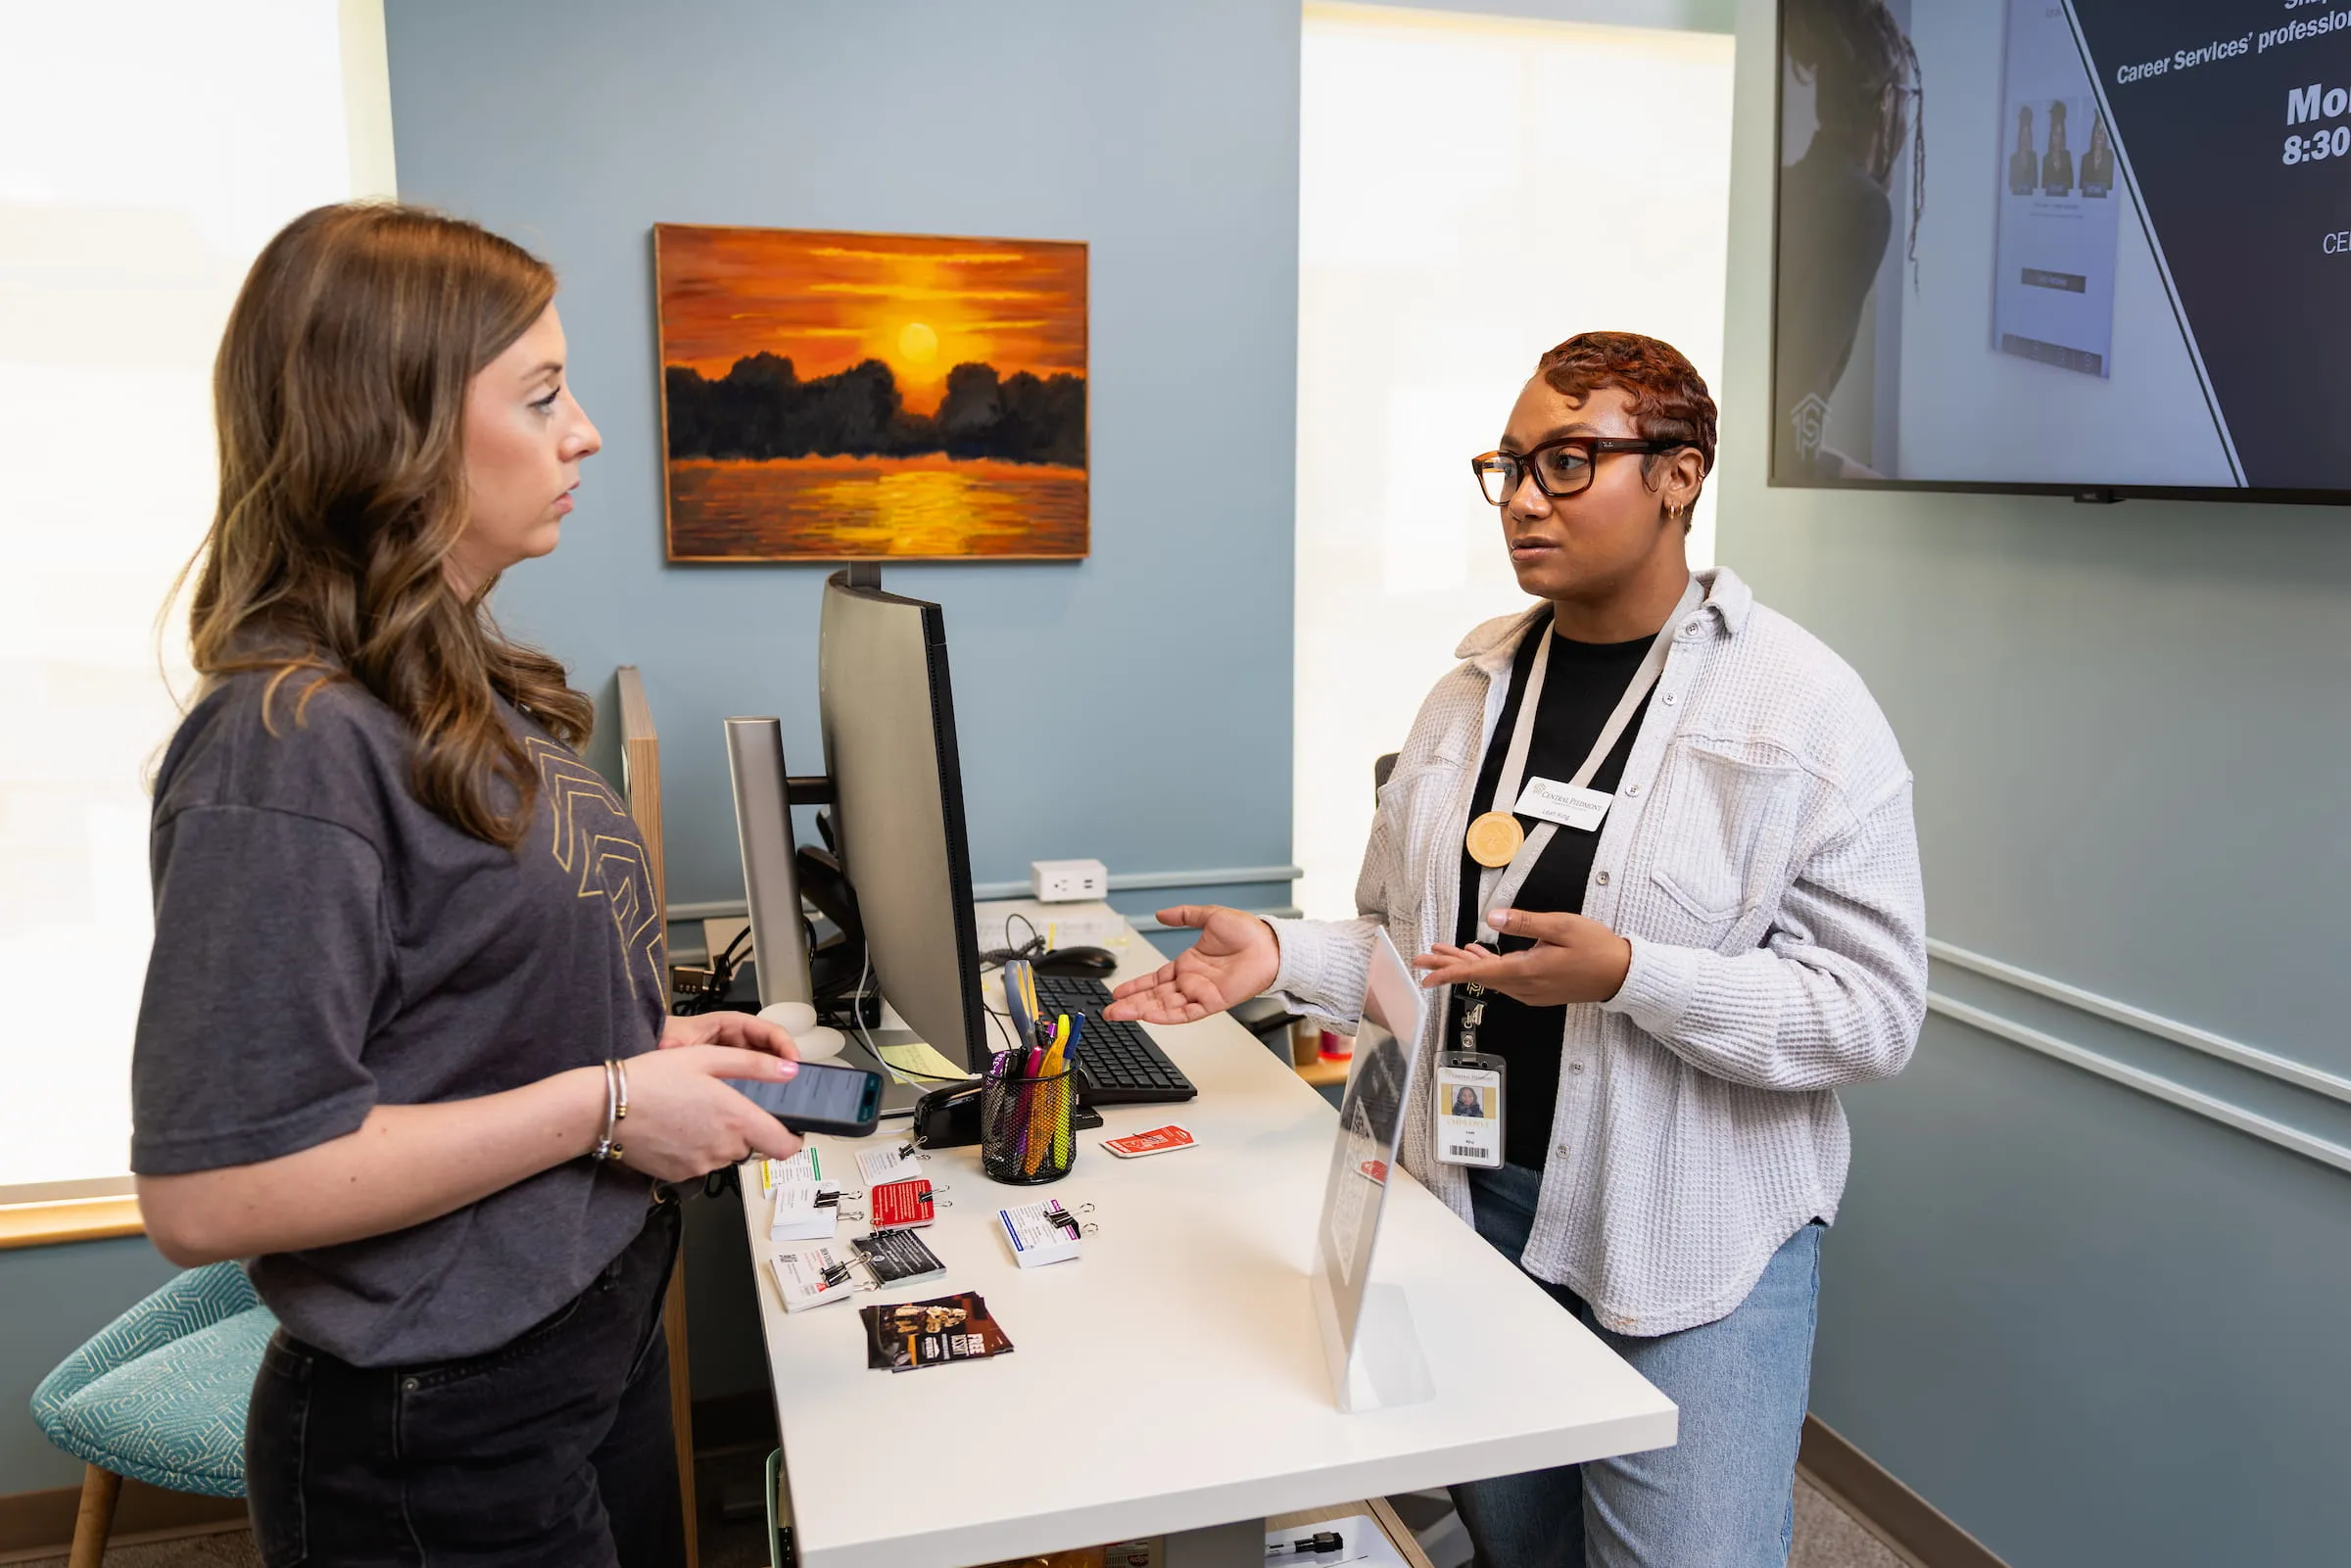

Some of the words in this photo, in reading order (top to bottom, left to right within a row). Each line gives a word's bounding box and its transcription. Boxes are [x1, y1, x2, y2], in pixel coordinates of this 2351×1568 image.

[2117, 57, 2171, 84] Career
[2287, 83, 2351, 126] Mo
[2282, 126, 2351, 166] 8:30
[2323, 228, 2351, 255] CE
[1542, 791, 1569, 803] CENTRAL
[1569, 797, 1603, 812] PIEDMONT
[967, 1333, 985, 1354] FREE
